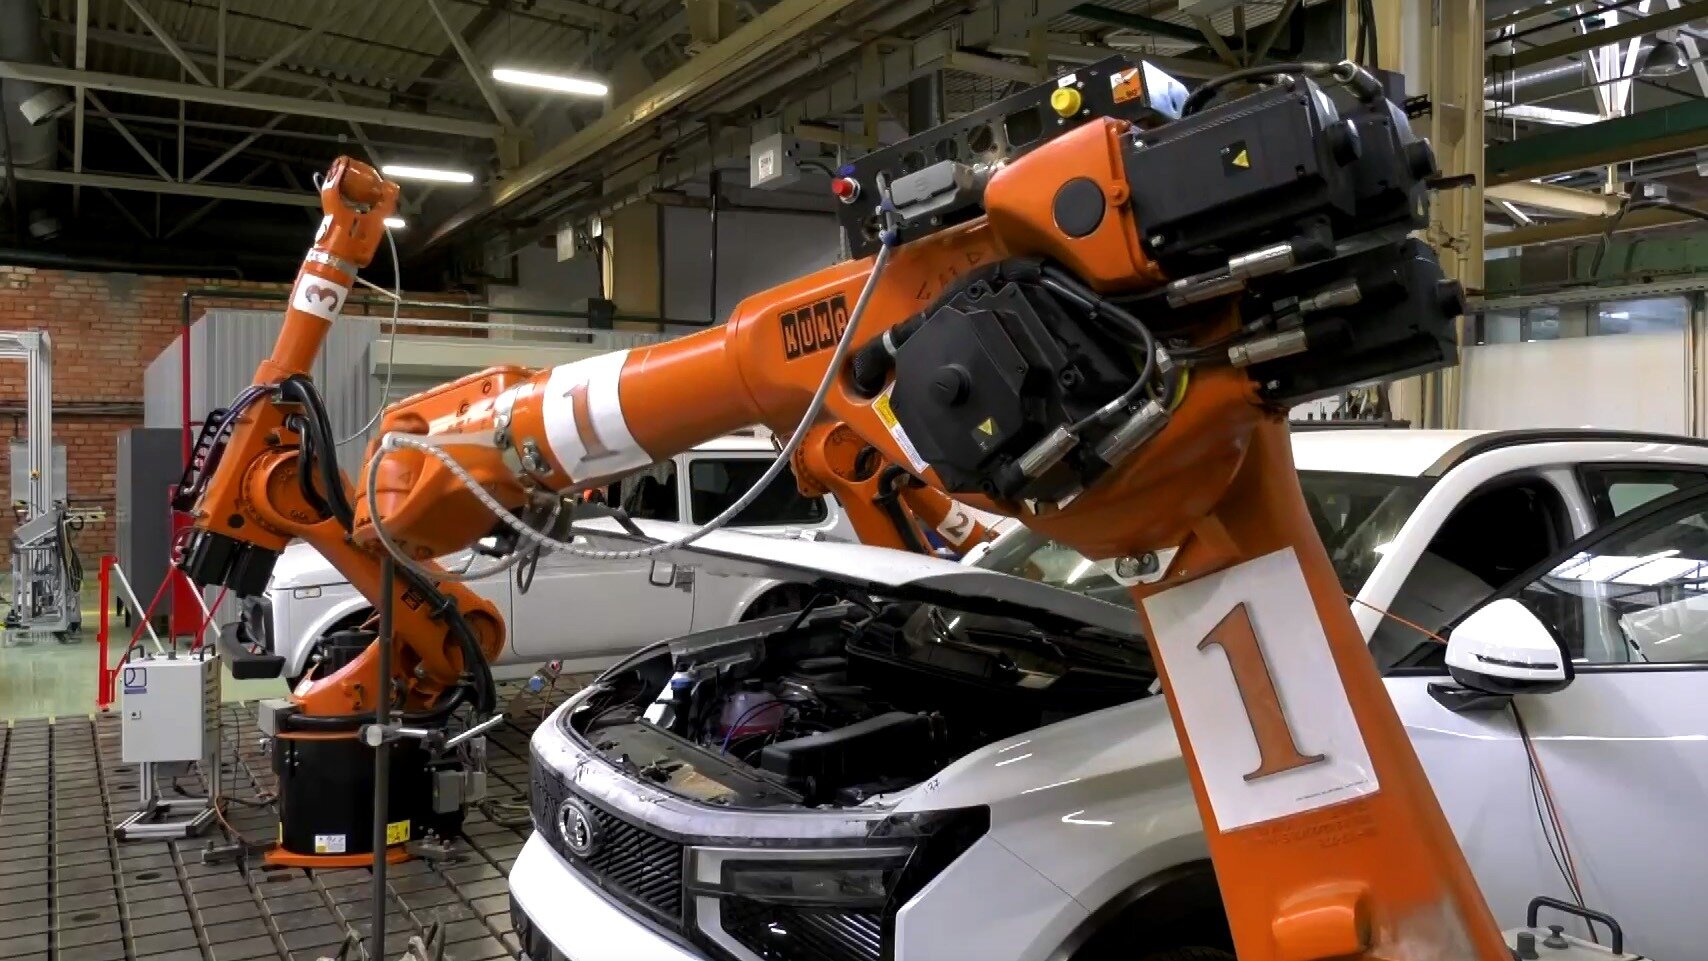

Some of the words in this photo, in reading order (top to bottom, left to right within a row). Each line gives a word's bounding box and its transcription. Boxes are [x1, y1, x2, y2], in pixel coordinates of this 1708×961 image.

[305, 284, 339, 312] 3
[784, 307, 848, 354] KUKA
[562, 379, 620, 462] 1
[945, 511, 969, 538] 2
[1196, 601, 1325, 782] 1
